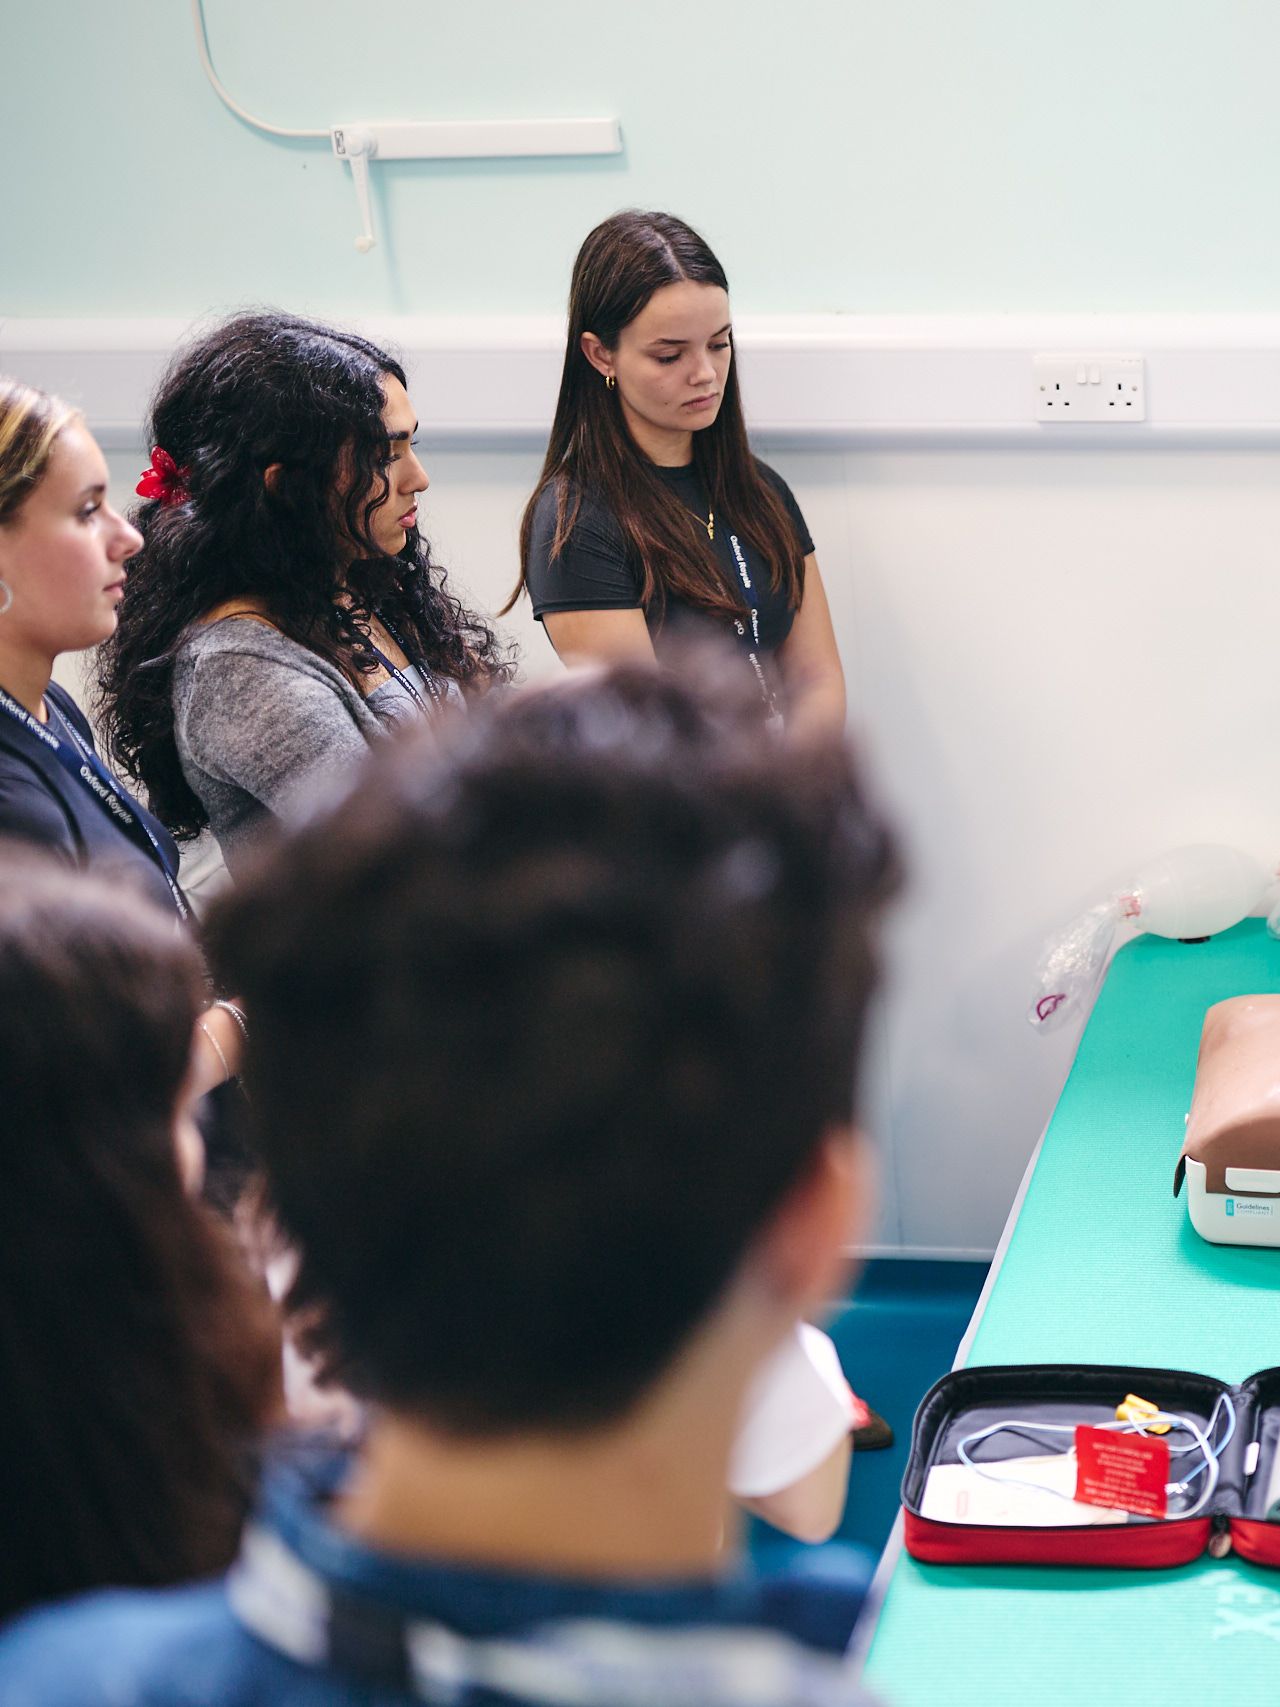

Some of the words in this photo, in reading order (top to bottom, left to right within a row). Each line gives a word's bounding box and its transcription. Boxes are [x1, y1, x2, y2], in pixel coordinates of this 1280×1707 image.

[730, 535, 744, 562] Oxford
[738, 561, 751, 589] Royale
[27, 716, 60, 750] Royale
[80, 766, 109, 797] Oxford
[105, 795, 132, 824] Royale
